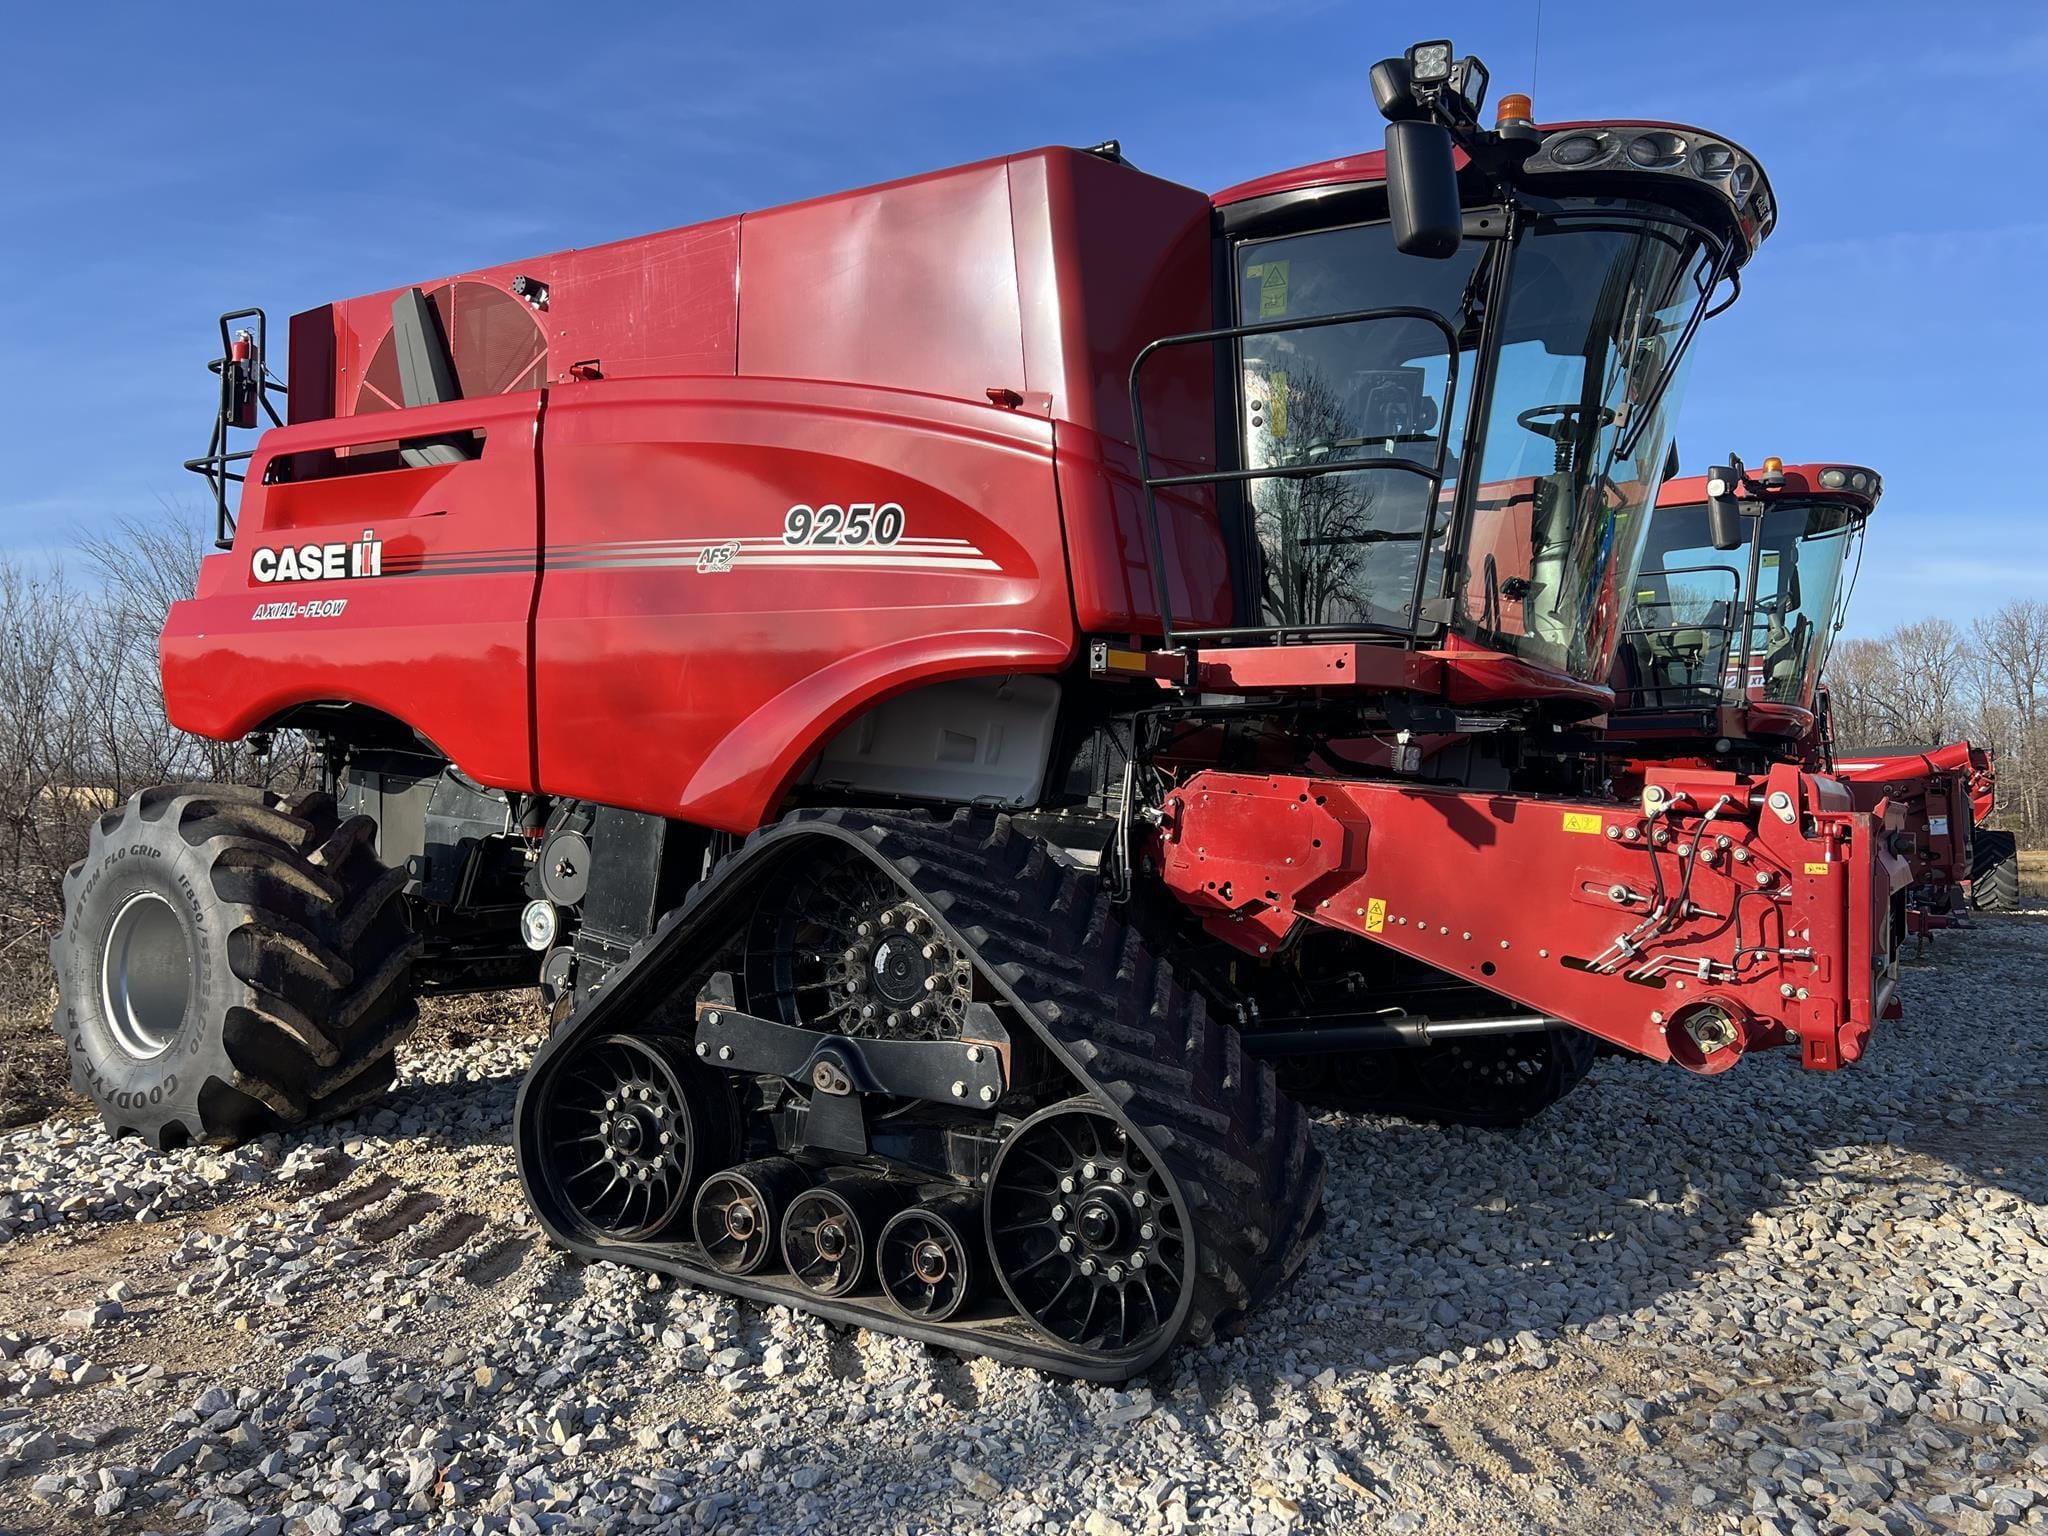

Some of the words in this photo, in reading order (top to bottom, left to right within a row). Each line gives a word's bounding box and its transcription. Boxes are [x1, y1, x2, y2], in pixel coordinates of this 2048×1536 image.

[783, 503, 905, 547] 9250
[252, 543, 347, 582] CASE
[698, 547, 731, 563] AFS
[252, 599, 347, 620] AXIAL-FLOW
[70, 868, 101, 944] CUSTOM
[104, 847, 126, 870] FLO
[129, 844, 161, 858] GRIP
[67, 1007, 179, 1109] GOODYEAR
